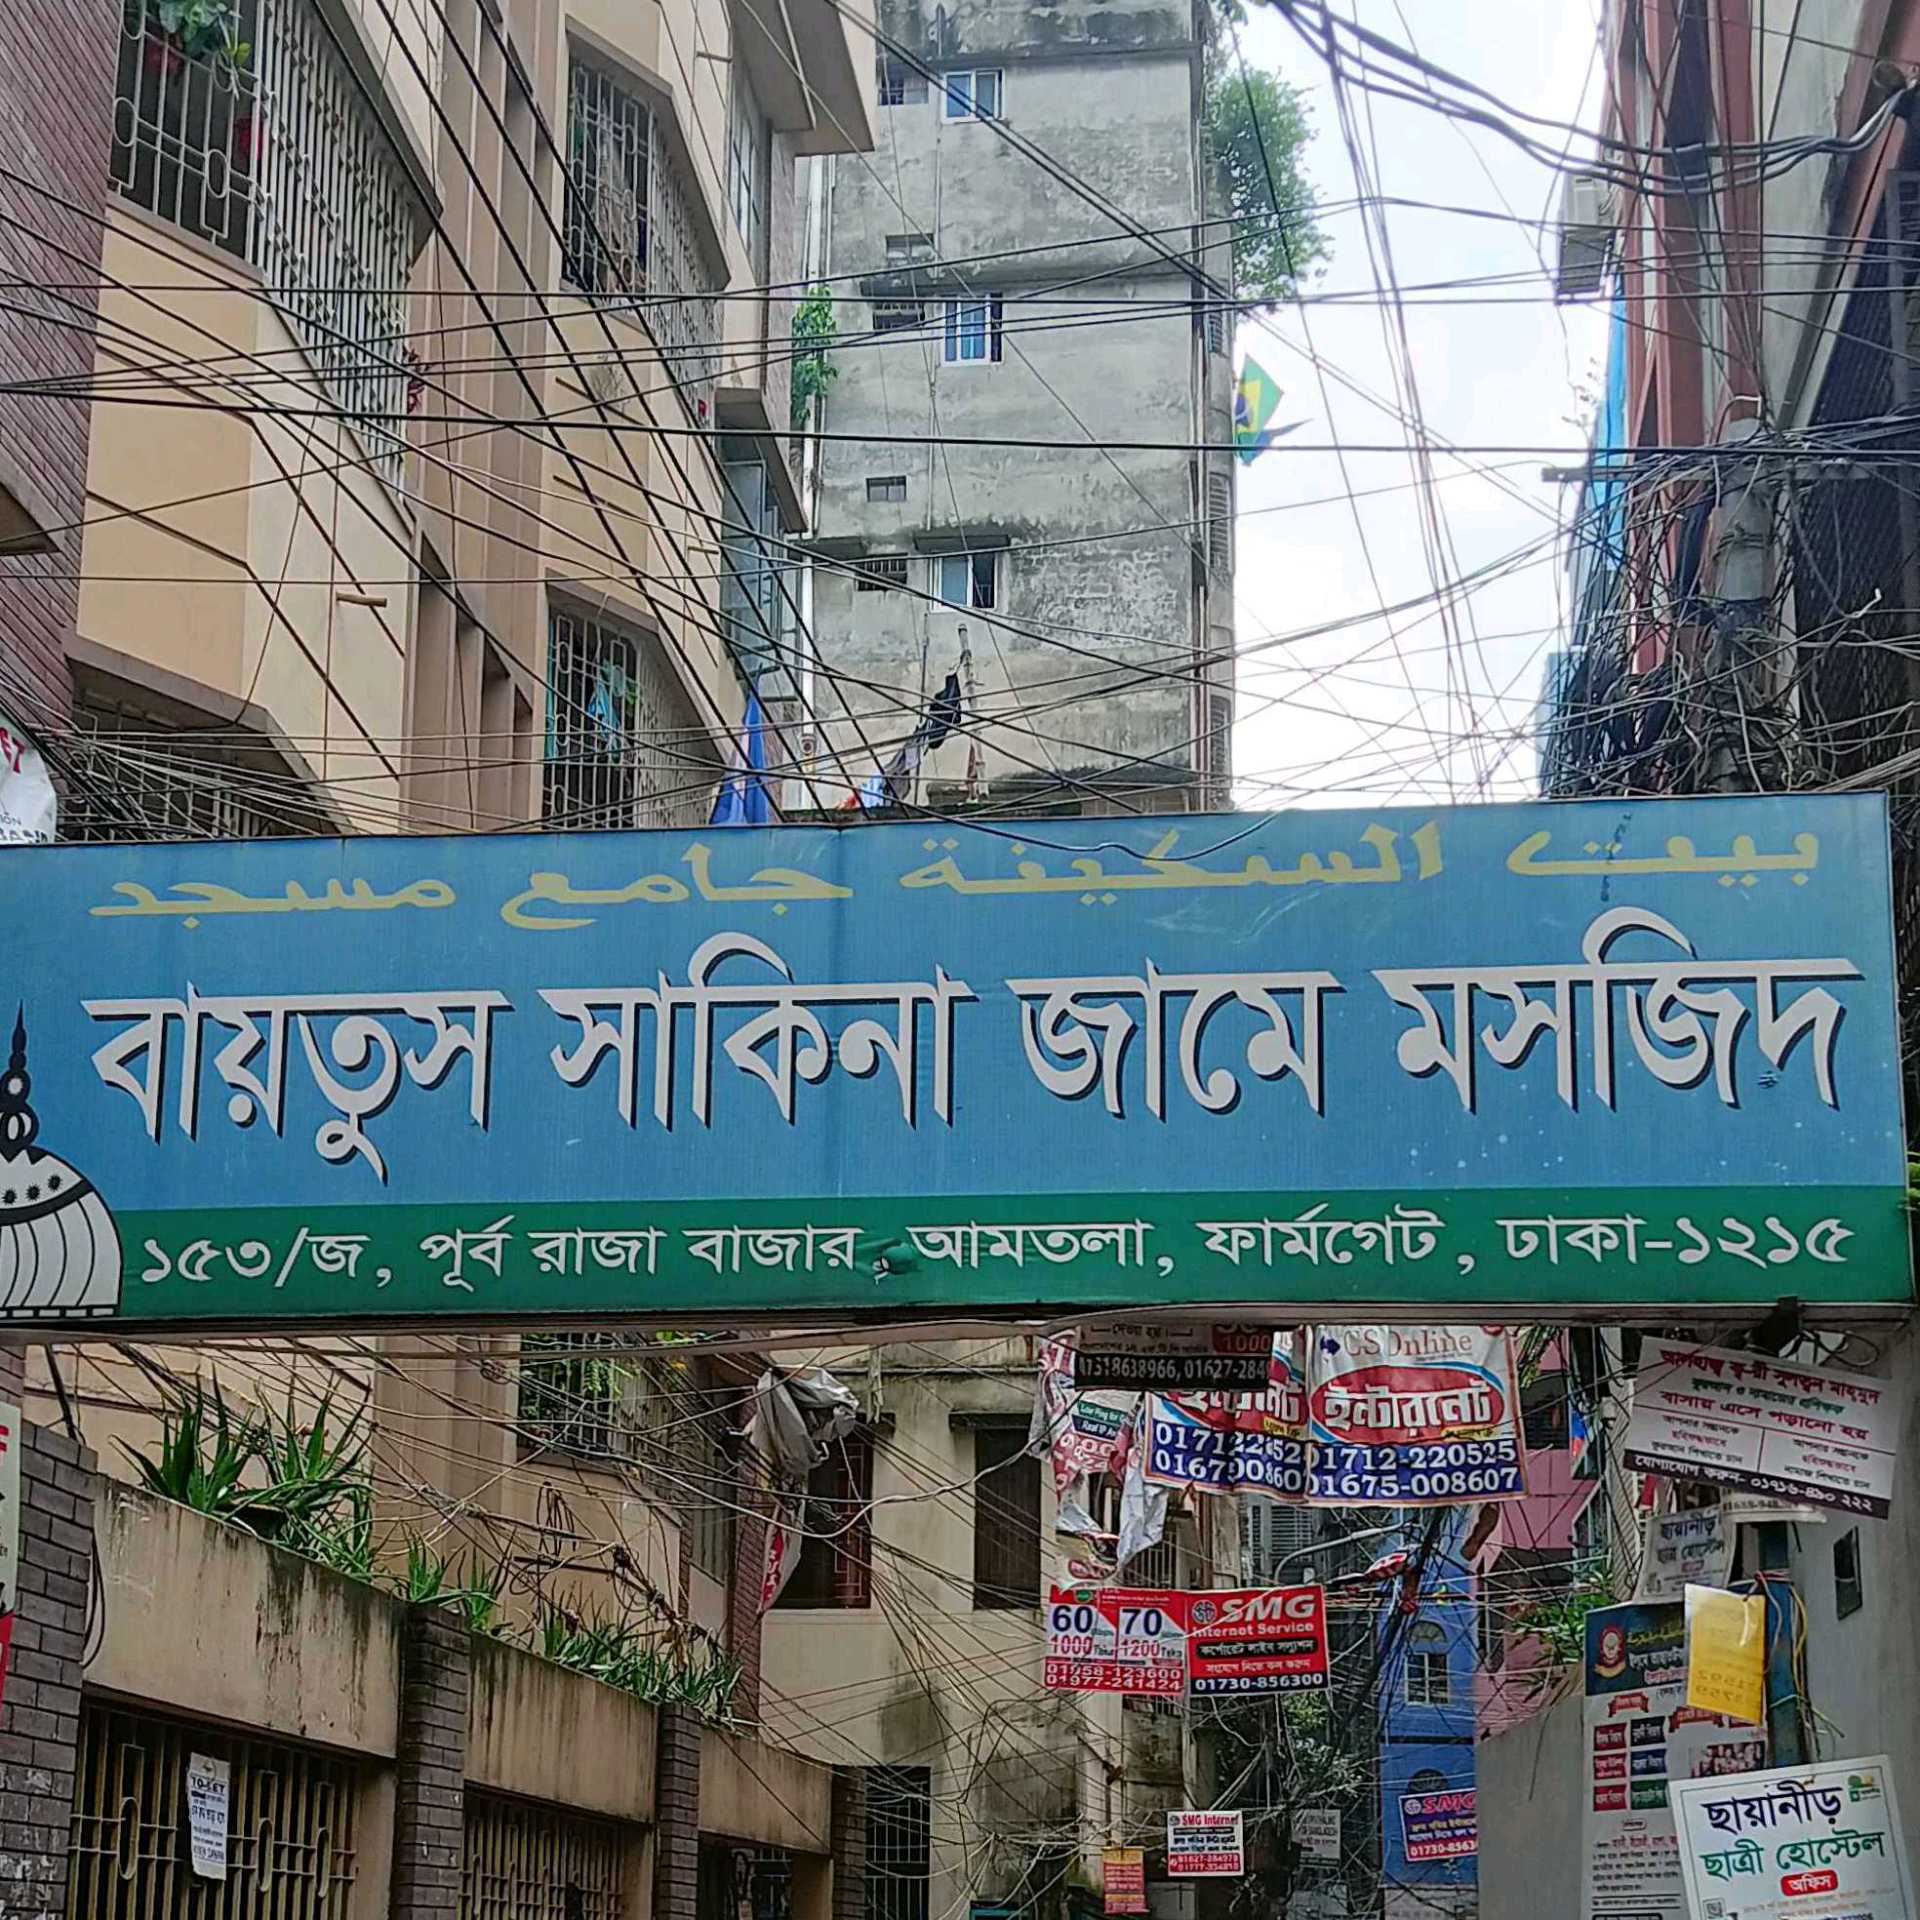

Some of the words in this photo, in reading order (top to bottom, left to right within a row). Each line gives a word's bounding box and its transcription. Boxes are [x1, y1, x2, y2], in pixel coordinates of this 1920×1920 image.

[88, 874, 454, 930] مسجد
[500, 842, 854, 930] جامع
[80, 981, 516, 1187] বায়তুস
[537, 931, 977, 1131] সাকিনা
[1005, 957, 1347, 1122] জামে
[1371, 906, 1866, 1114] মসজিদ
[419, 1215, 516, 1292] পূর্ব
[527, 1225, 668, 1276] রাজা
[1323, 1377, 1492, 1437] ইন্টারনেট
[1052, 1604, 1094, 1634] 60
[1122, 1607, 1163, 1637] 70
[1221, 1594, 1316, 1624] SMG
[1257, 1621, 1315, 1635] Service
[1195, 1673, 1324, 1691] 01730-856300
[1700, 1779, 1844, 1835] ছায়ানীড়
[1698, 1838, 1766, 1882] ছাত্রী
[1776, 1827, 1887, 1871] হোস্টেল
